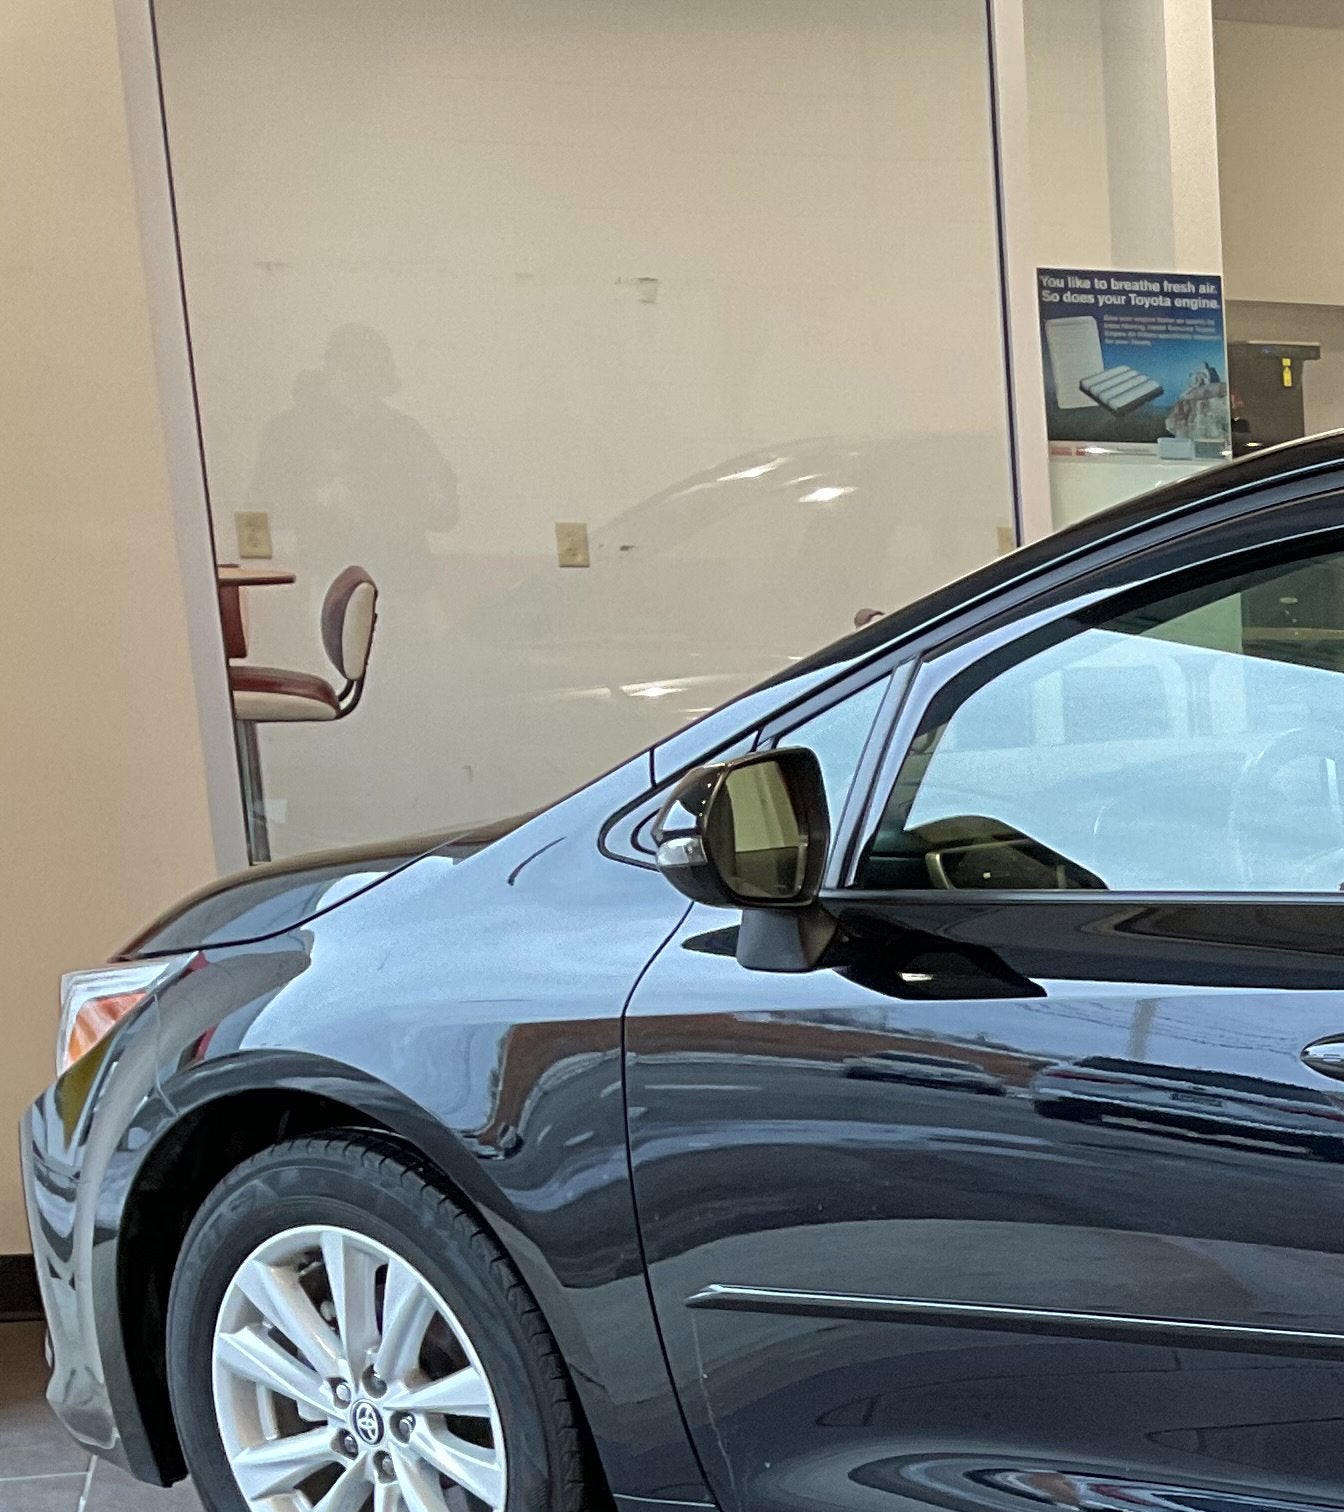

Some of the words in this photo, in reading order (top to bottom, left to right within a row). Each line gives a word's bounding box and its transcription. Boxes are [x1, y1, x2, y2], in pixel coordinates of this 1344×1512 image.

[1041, 275, 1065, 290] You
[1068, 276, 1091, 289] like
[1094, 278, 1108, 290] to
[1111, 278, 1160, 293] breathe
[1163, 279, 1195, 293] fresh
[1198, 281, 1217, 294] air.
[1042, 290, 1060, 302] So
[1063, 291, 1095, 304] does
[1097, 294, 1126, 307] your
[1129, 293, 1171, 308] Toyota
[1174, 296, 1221, 310] engine.
